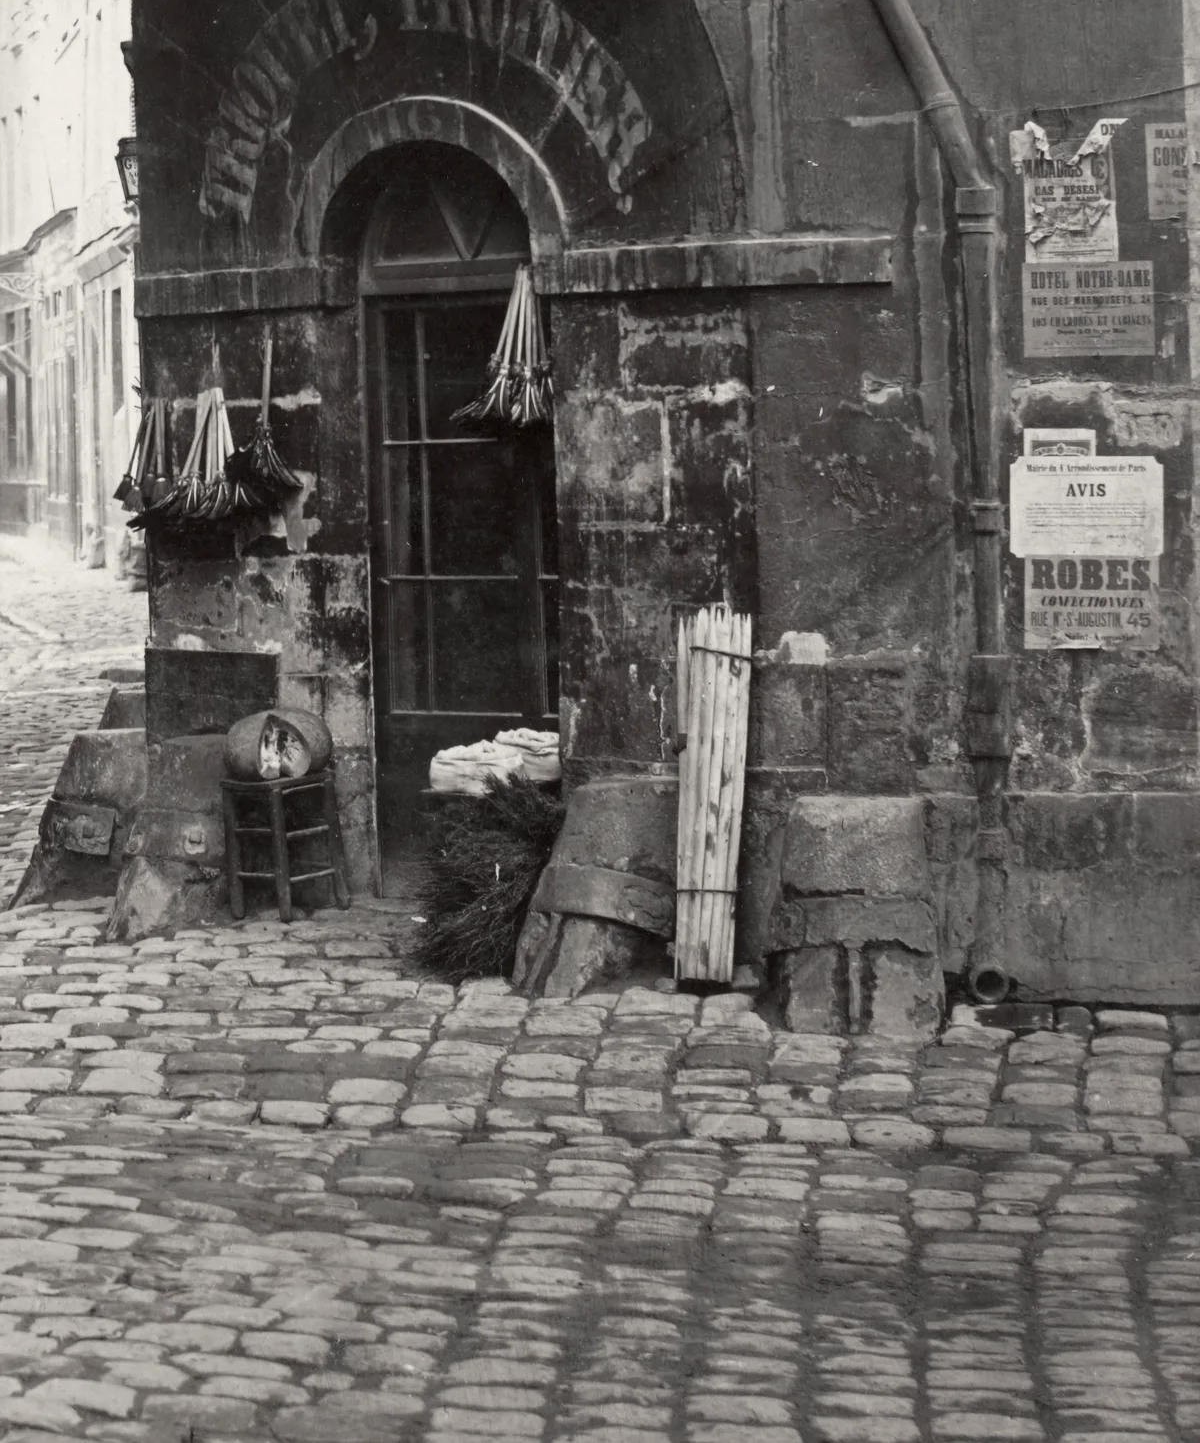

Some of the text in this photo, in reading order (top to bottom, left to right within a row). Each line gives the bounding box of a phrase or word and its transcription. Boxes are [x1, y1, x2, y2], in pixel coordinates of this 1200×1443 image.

[1035, 185, 1055, 196] CAS
[1030, 270, 1070, 289] HOTEL
[1031, 297, 1049, 306] RUE
[1066, 483, 1106, 497] AVIS
[1031, 558, 1150, 591] ROBES
[1031, 611, 1048, 627] RUE
[1126, 612, 1151, 628] 45
